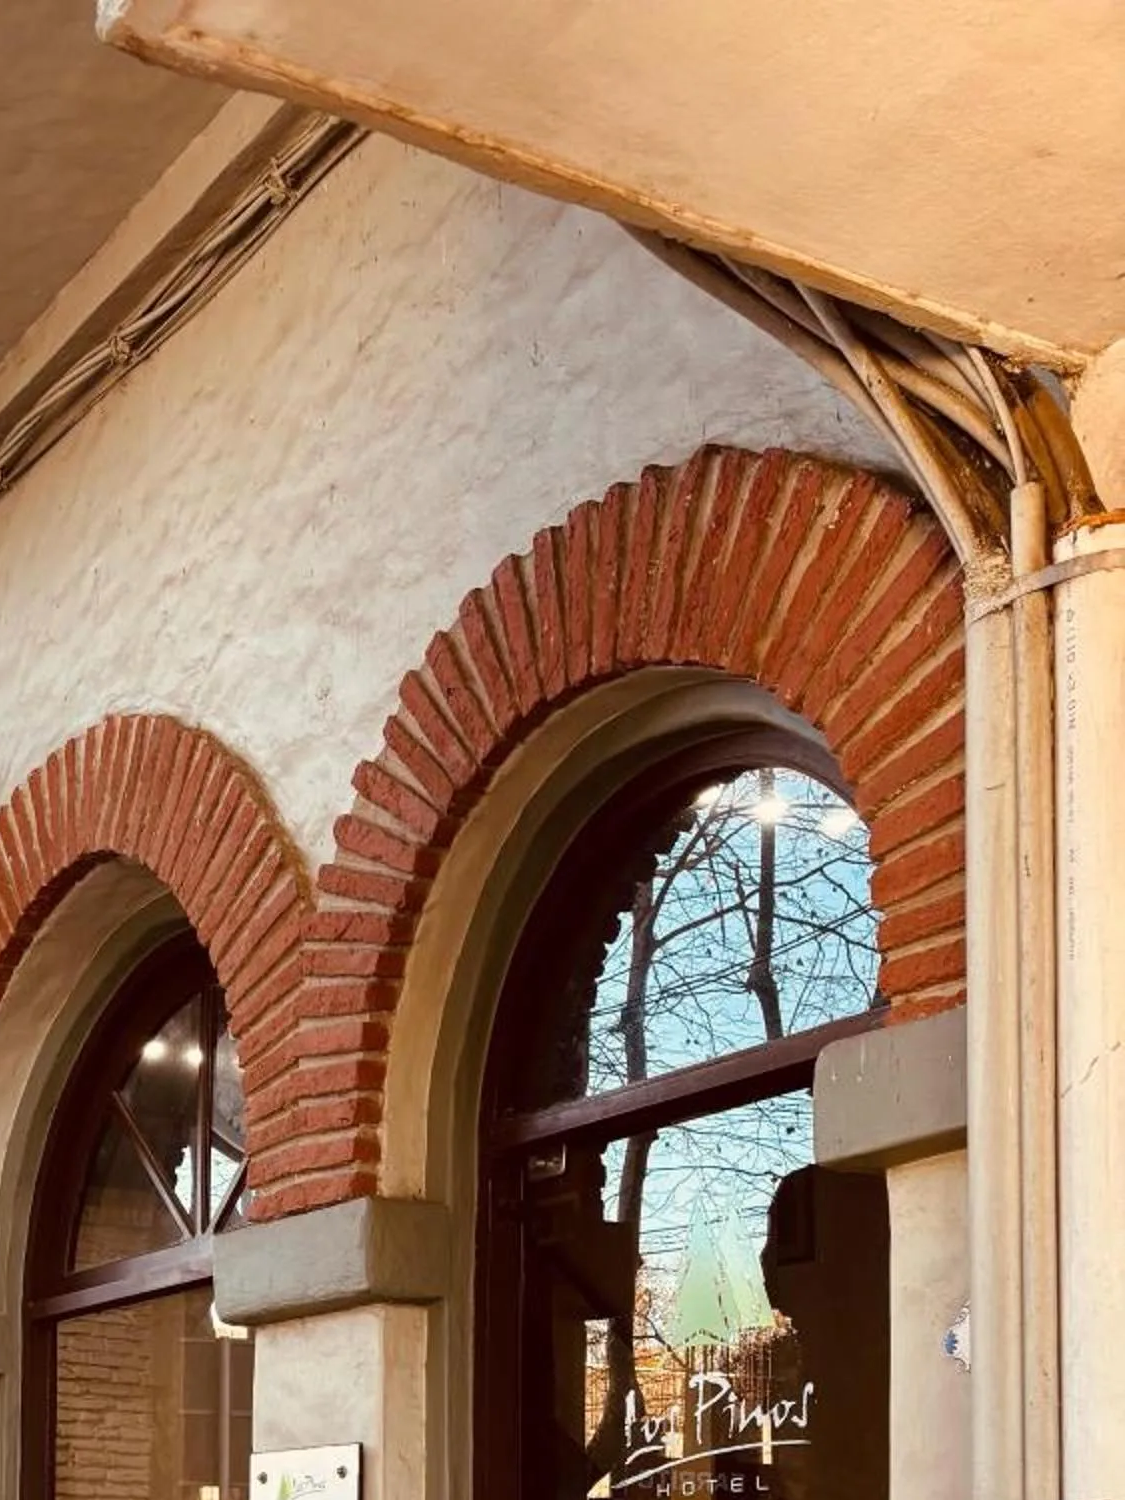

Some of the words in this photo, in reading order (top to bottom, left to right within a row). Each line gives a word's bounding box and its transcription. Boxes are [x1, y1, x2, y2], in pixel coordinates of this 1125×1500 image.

[624, 1389, 681, 1464] Los
[689, 1372, 814, 1445] Pinos
[656, 1475, 770, 1497] HOTEL
